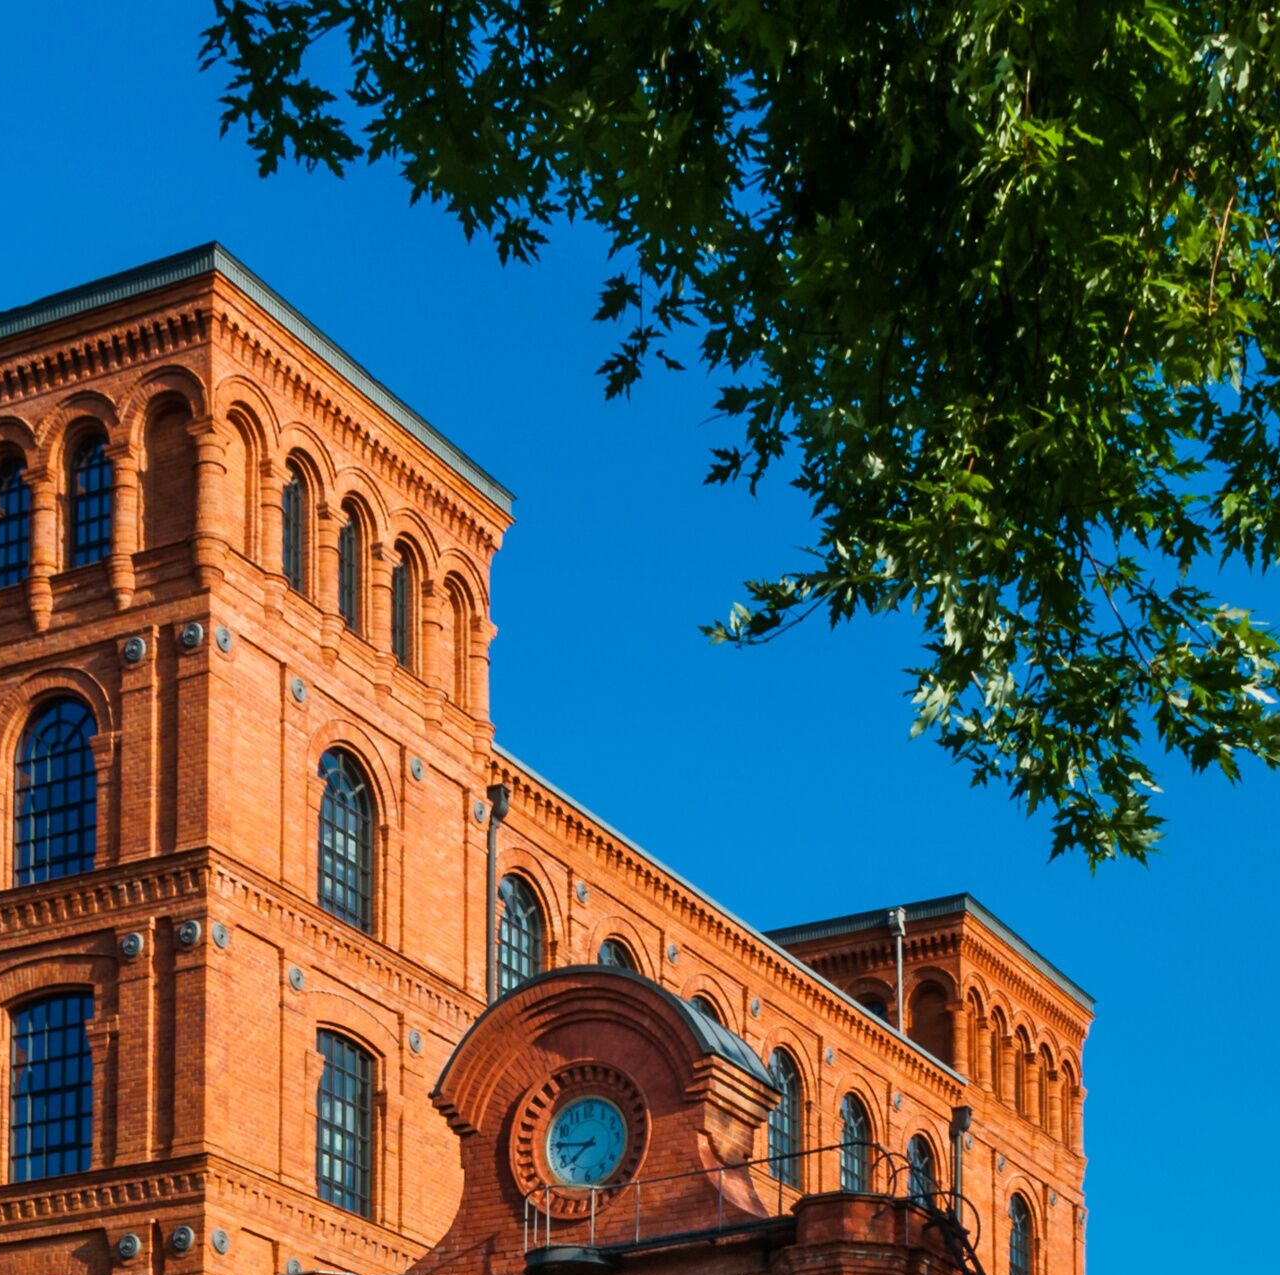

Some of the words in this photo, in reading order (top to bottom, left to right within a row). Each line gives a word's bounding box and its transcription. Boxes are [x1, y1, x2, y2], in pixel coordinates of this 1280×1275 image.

[570, 1110, 579, 1125] 11
[583, 1104, 594, 1119] 12
[609, 1116, 616, 1130] 2
[560, 1123, 569, 1138] 10
[613, 1132, 620, 1146] 3
[560, 1154, 567, 1168] 8
[569, 1167, 576, 1178] 7
[584, 1170, 591, 1182] 6
